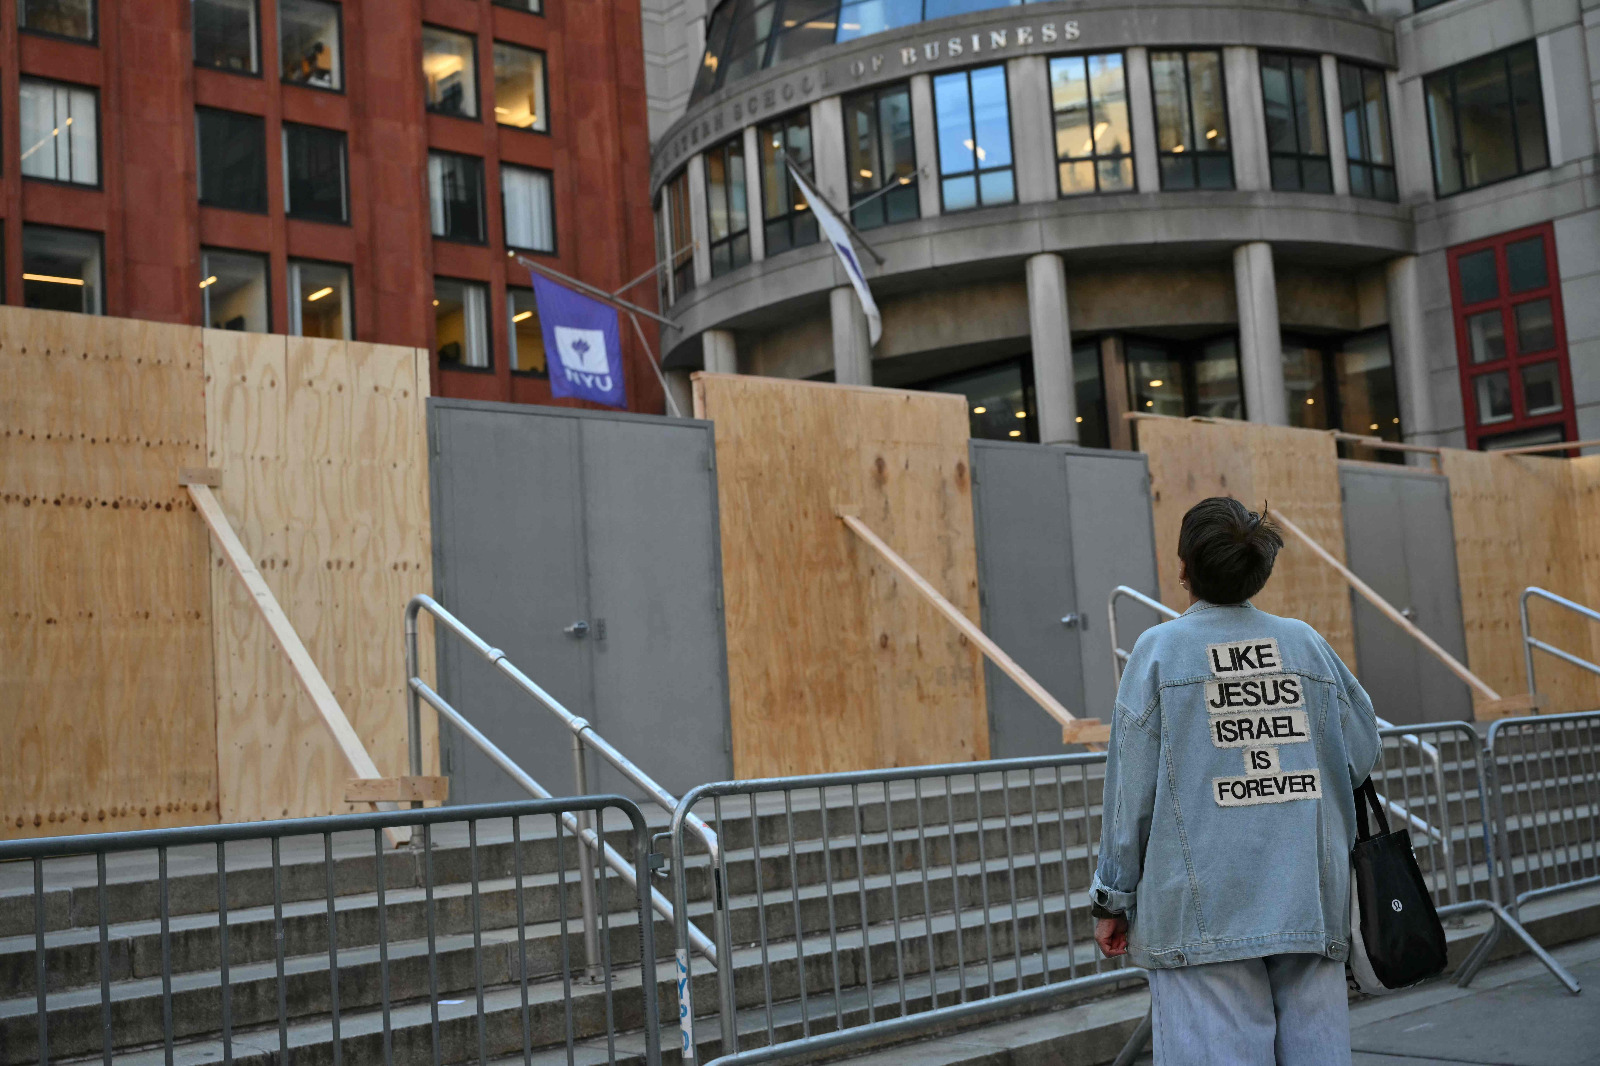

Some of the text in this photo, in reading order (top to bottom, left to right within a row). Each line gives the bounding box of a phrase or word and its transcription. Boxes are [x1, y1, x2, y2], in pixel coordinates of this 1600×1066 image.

[733, 67, 833, 121] SCHOOL
[850, 53, 885, 78] OF
[901, 20, 1082, 66] BUSINESS
[565, 368, 613, 392] NYU
[1211, 643, 1277, 673] LIKE
[1209, 679, 1300, 709] JESUS
[1216, 715, 1306, 743] ISRAEL
[1251, 750, 1272, 771] IS
[1218, 774, 1316, 801] FOREVER
